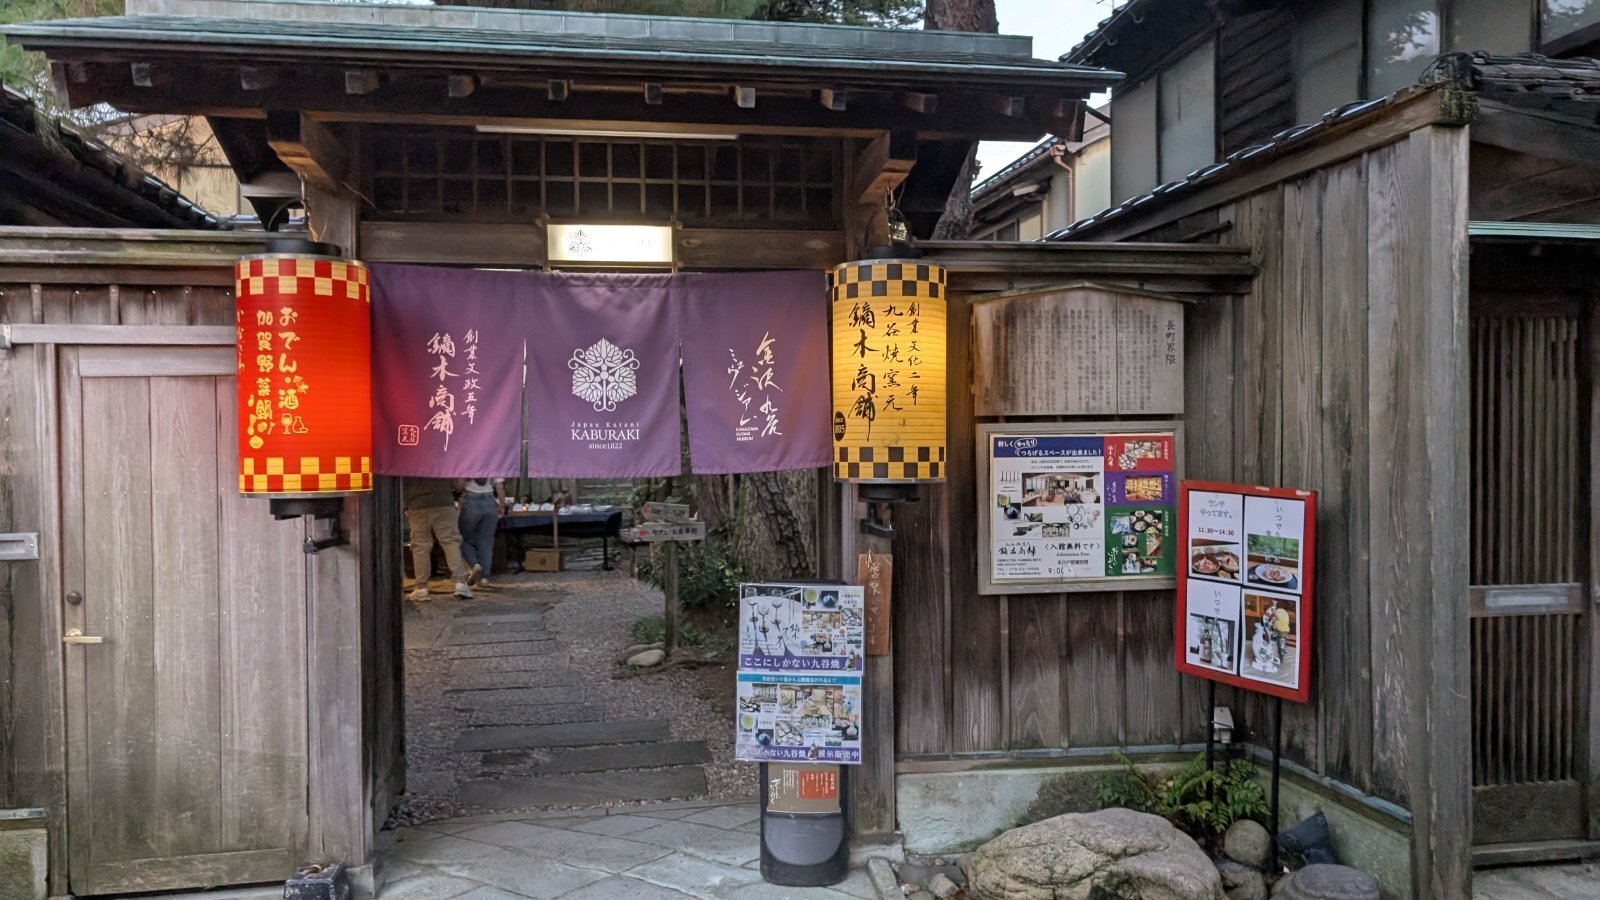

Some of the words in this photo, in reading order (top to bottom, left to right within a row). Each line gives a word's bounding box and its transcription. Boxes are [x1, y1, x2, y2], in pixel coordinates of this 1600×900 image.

[256, 310, 273, 420] 加賀野菜鍋
[278, 306, 300, 409] おでん・酒
[424, 332, 460, 452] 鏑木商舗
[462, 329, 481, 424] 創業文政五年
[848, 302, 879, 441] 鏑木商舗
[882, 304, 903, 411] 九谷焼窯元
[906, 302, 922, 404] 創業文化二年
[571, 429, 640, 441] KABURAKI
[744, 657, 840, 669] ここにしかない九谷焼
[817, 750, 859, 760] 展示販売中
